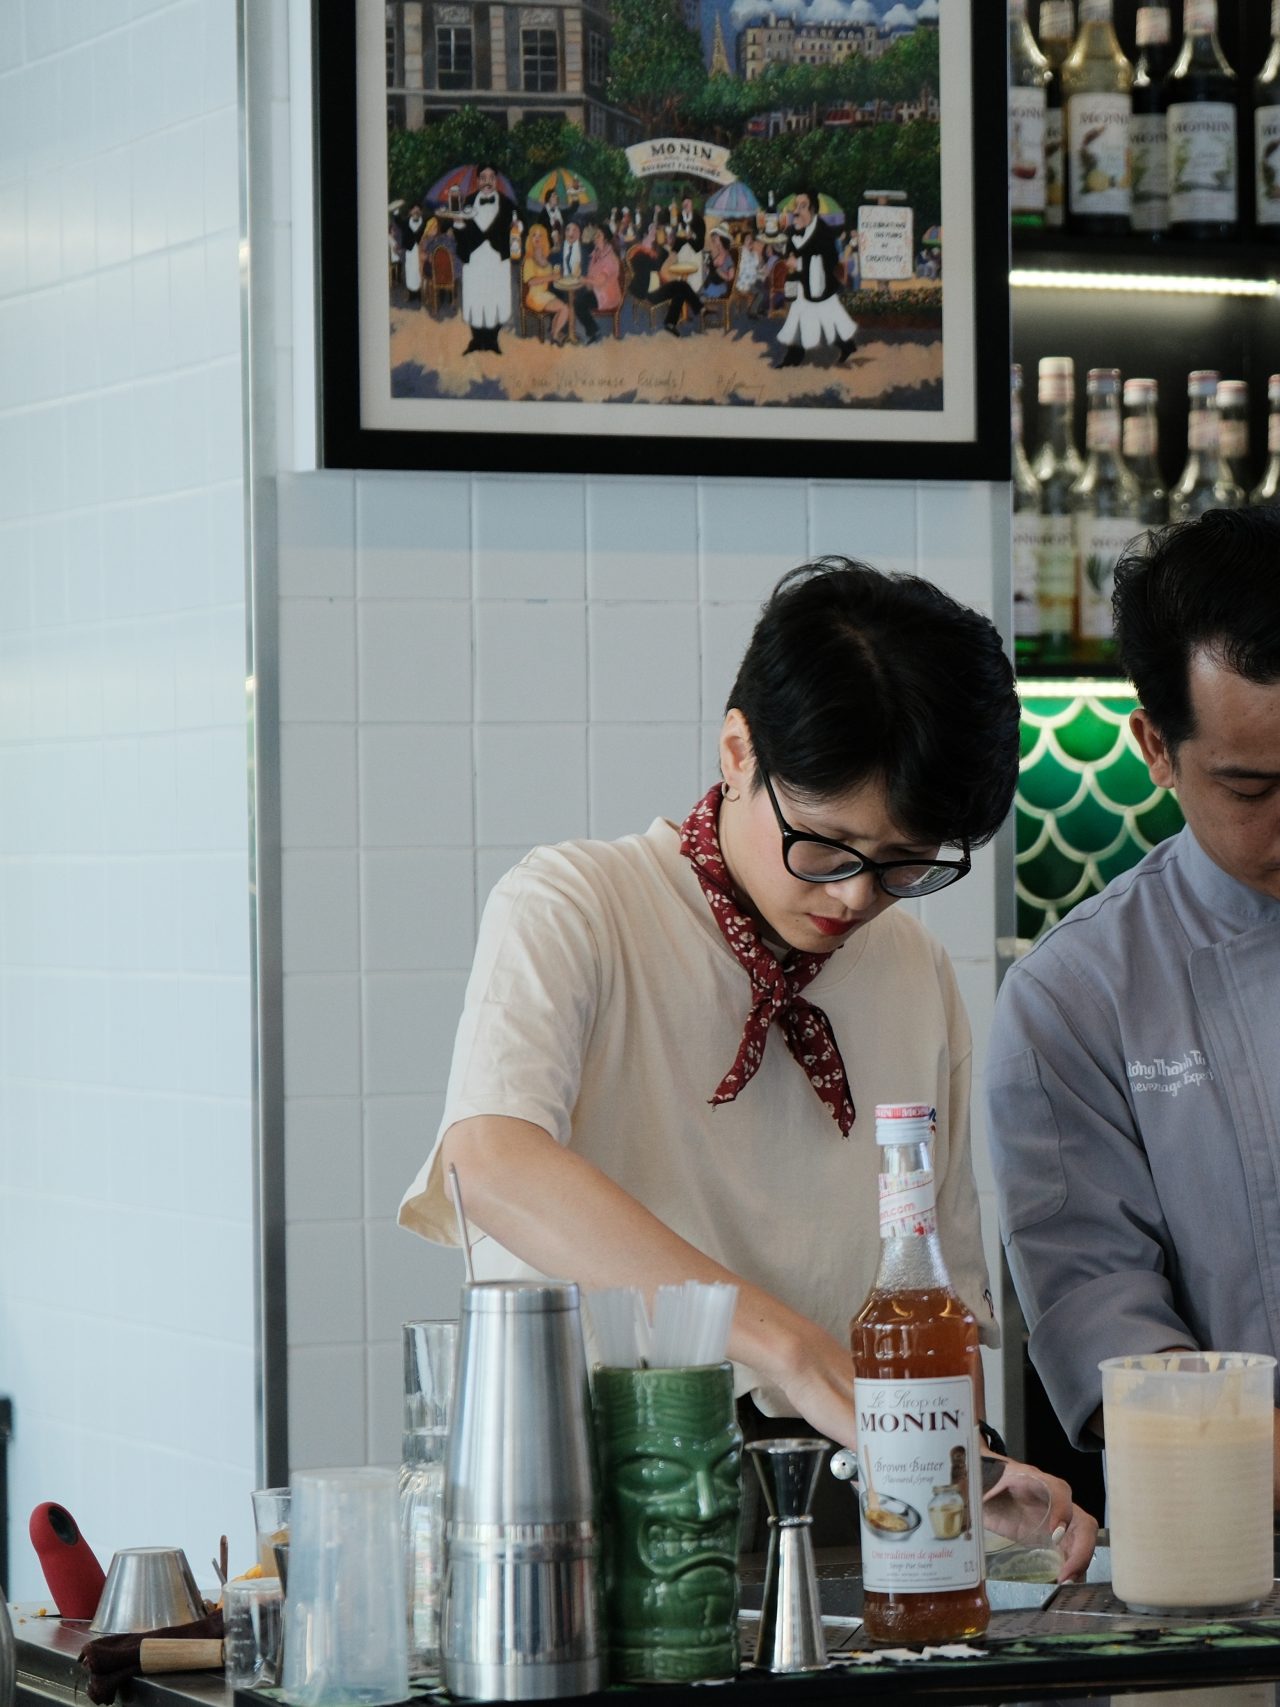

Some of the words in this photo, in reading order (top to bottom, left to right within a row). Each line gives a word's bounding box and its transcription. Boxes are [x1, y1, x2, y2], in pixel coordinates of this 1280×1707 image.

[650, 142, 712, 160] MONIN
[860, 1409, 960, 1433] MONIN
[874, 1457, 906, 1473] Brown
[908, 1456, 944, 1473] Butter
